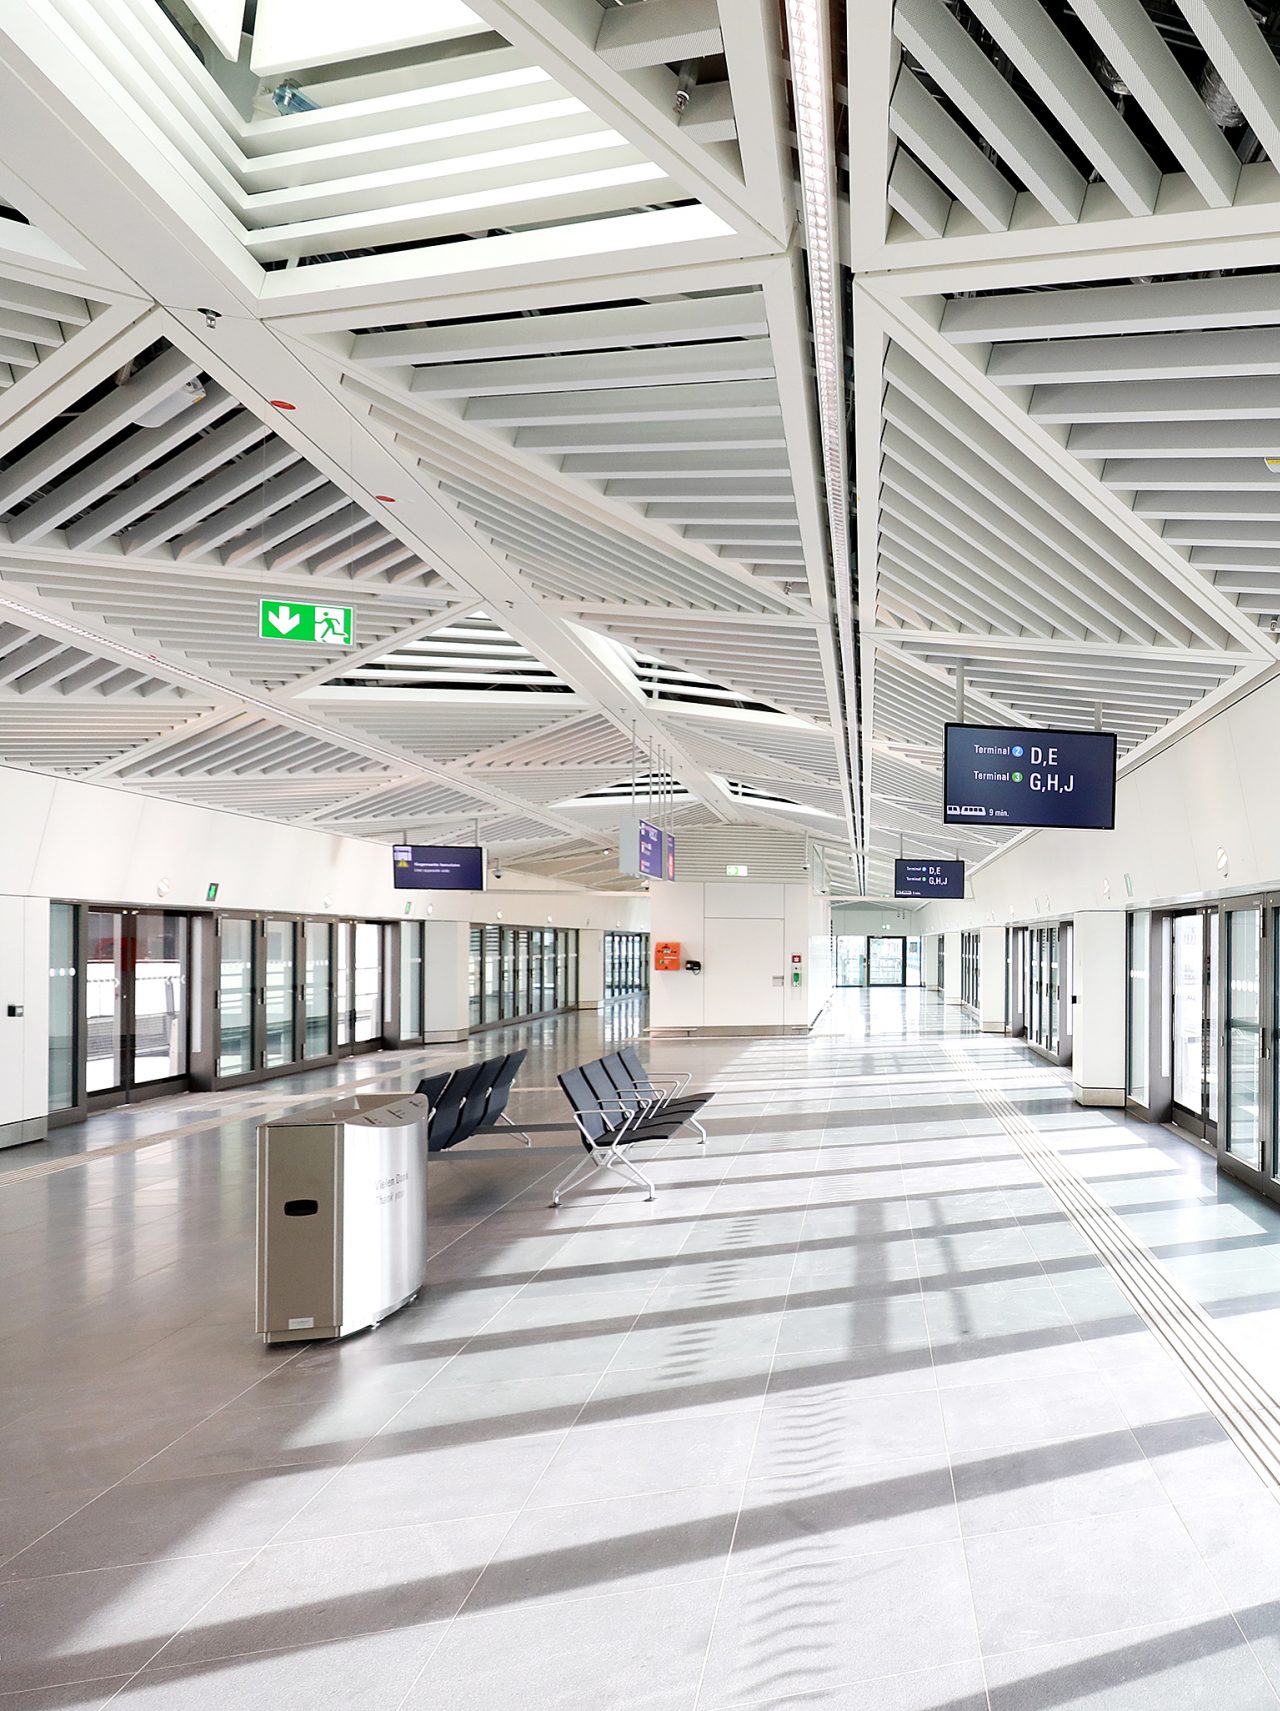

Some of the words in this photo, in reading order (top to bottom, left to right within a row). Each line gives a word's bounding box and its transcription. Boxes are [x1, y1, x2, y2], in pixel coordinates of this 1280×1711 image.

[974, 744, 1010, 755] Terminal
[1013, 746, 1022, 757] 2
[1031, 747, 1058, 766] D,E
[974, 770, 1009, 781] Terminal
[1013, 772, 1022, 782] 3
[1030, 773, 1074, 793] G,H,J
[989, 808, 994, 816] 9
[994, 809, 1010, 817] min.
